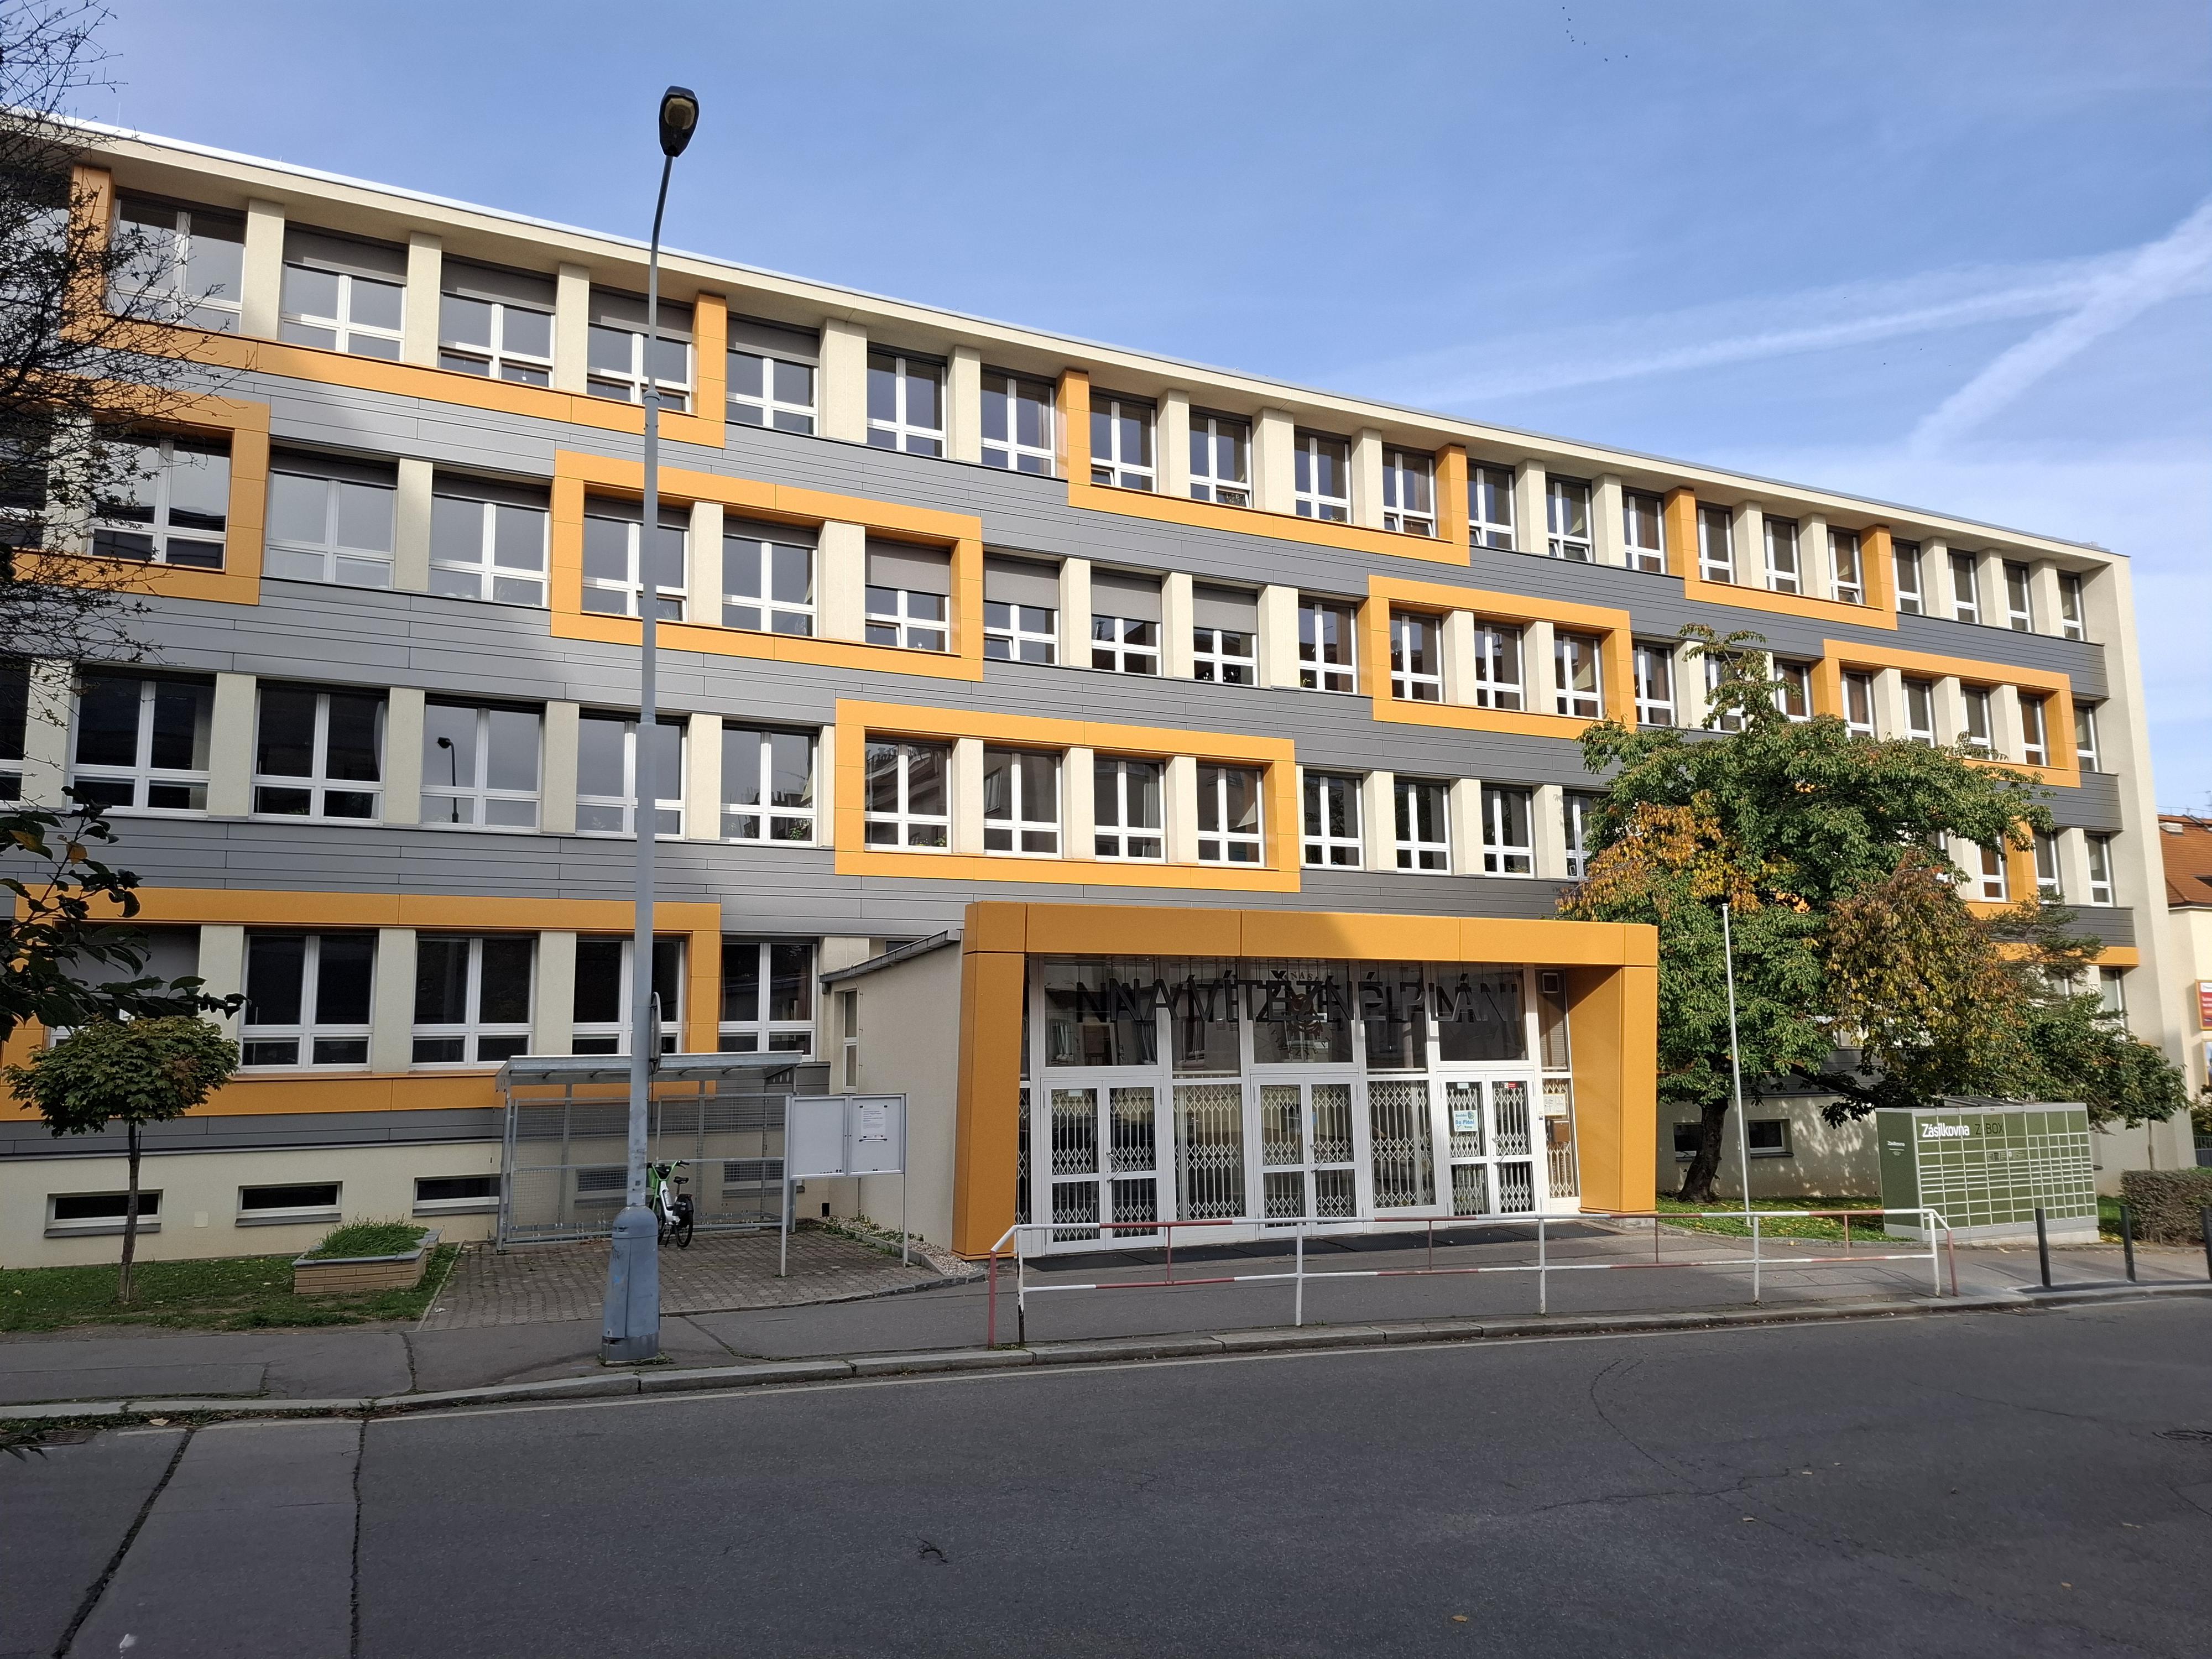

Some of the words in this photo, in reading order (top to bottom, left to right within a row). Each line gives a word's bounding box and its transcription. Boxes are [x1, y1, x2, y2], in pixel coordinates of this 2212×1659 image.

[1109, 978, 1180, 1021] NA
[1400, 973, 1521, 1021] PLÁNI
[1921, 1123, 1970, 1138] Zásilkovna
